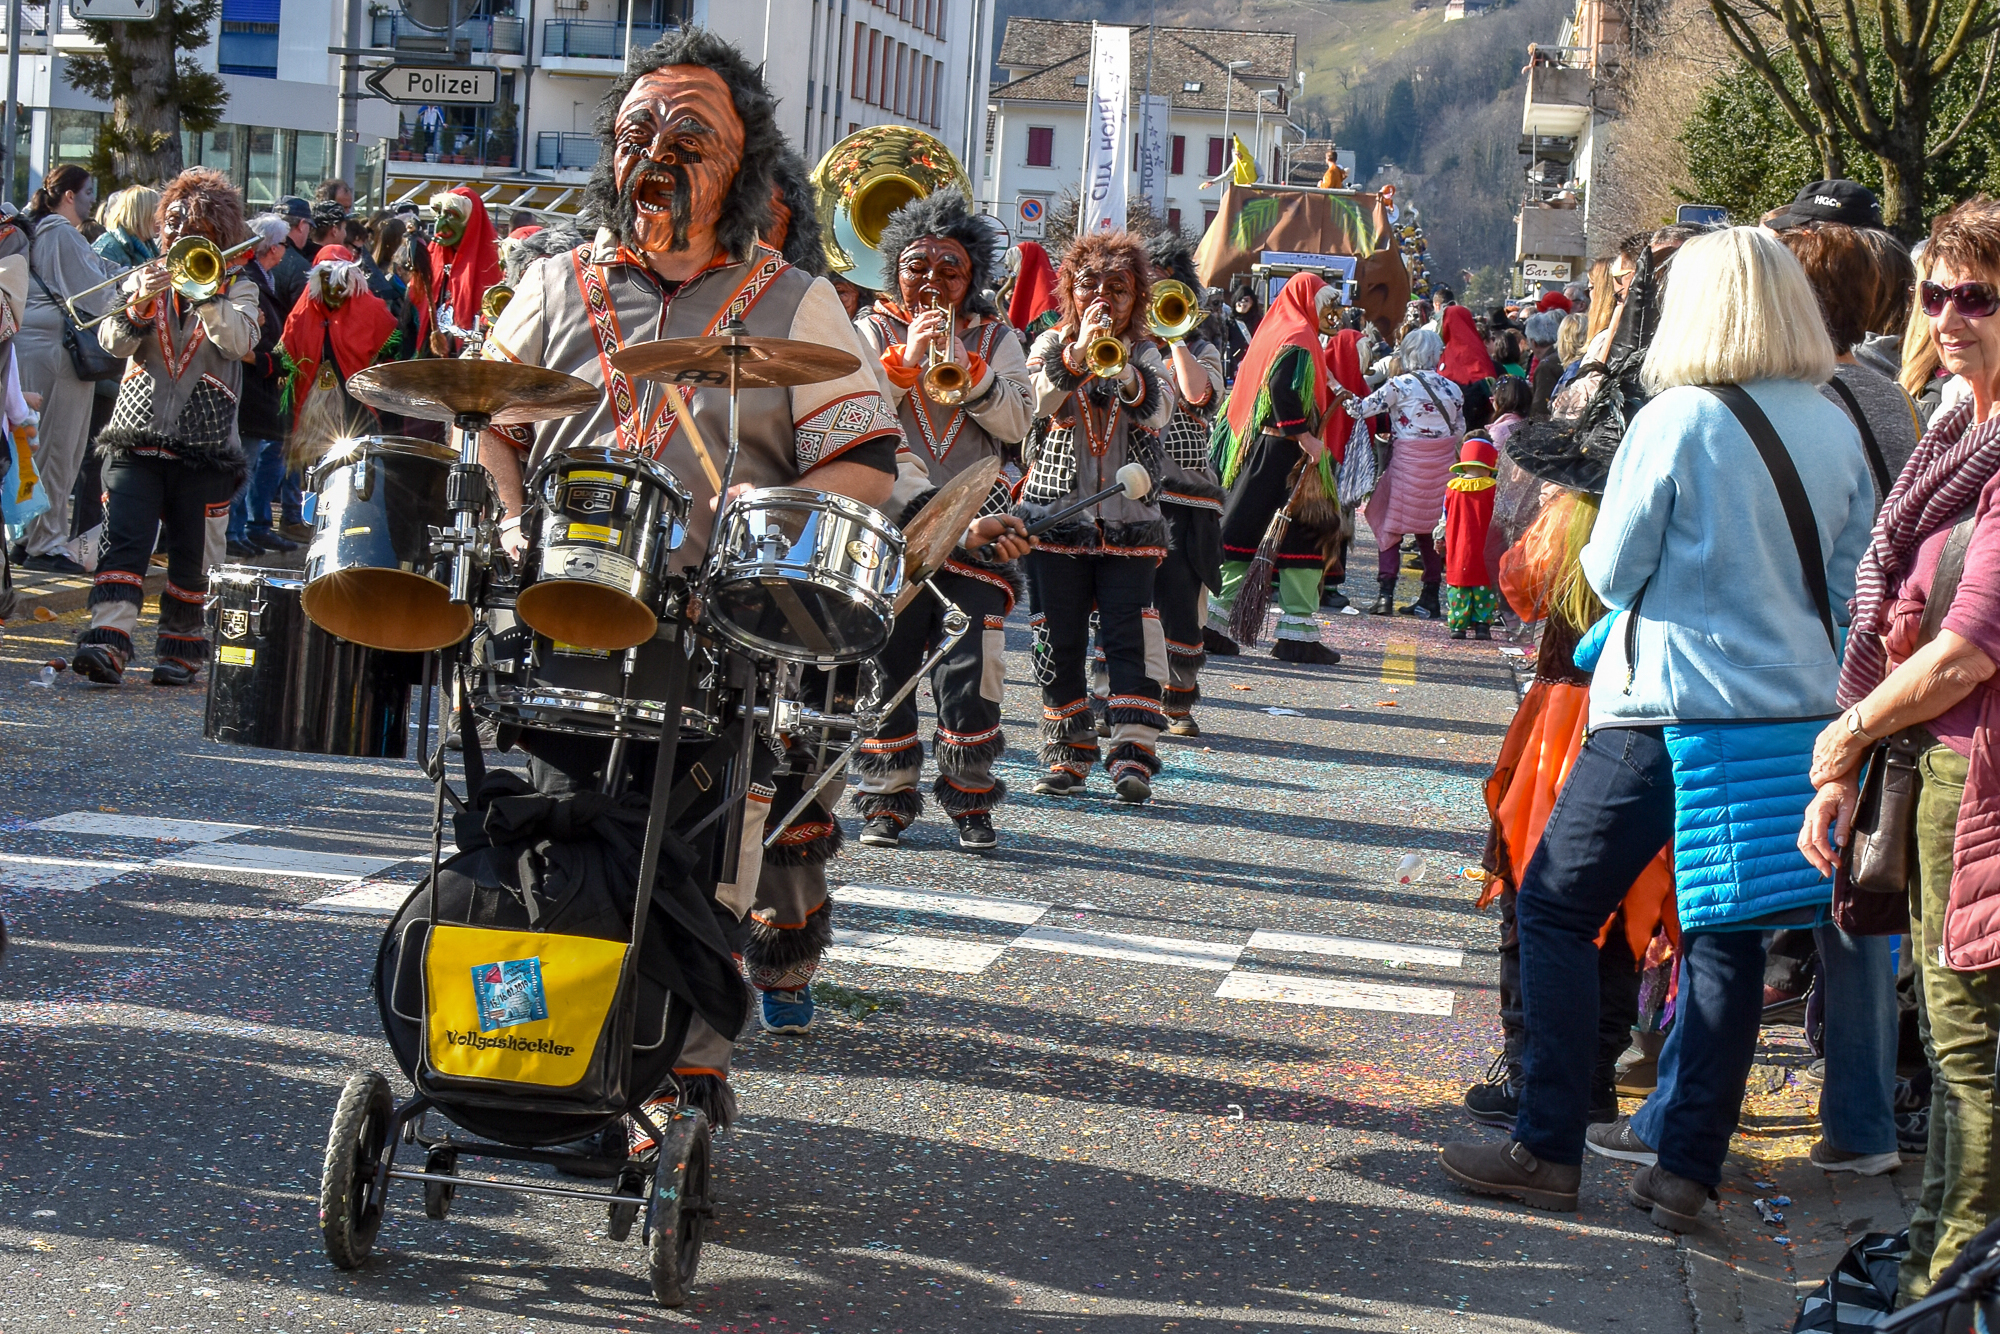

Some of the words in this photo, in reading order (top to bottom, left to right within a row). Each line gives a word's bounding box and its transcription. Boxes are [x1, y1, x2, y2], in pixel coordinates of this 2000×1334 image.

[408, 73, 478, 95] Polizei
[1525, 263, 1548, 276] Bar
[446, 1029, 575, 1056] Vollgashöckler
